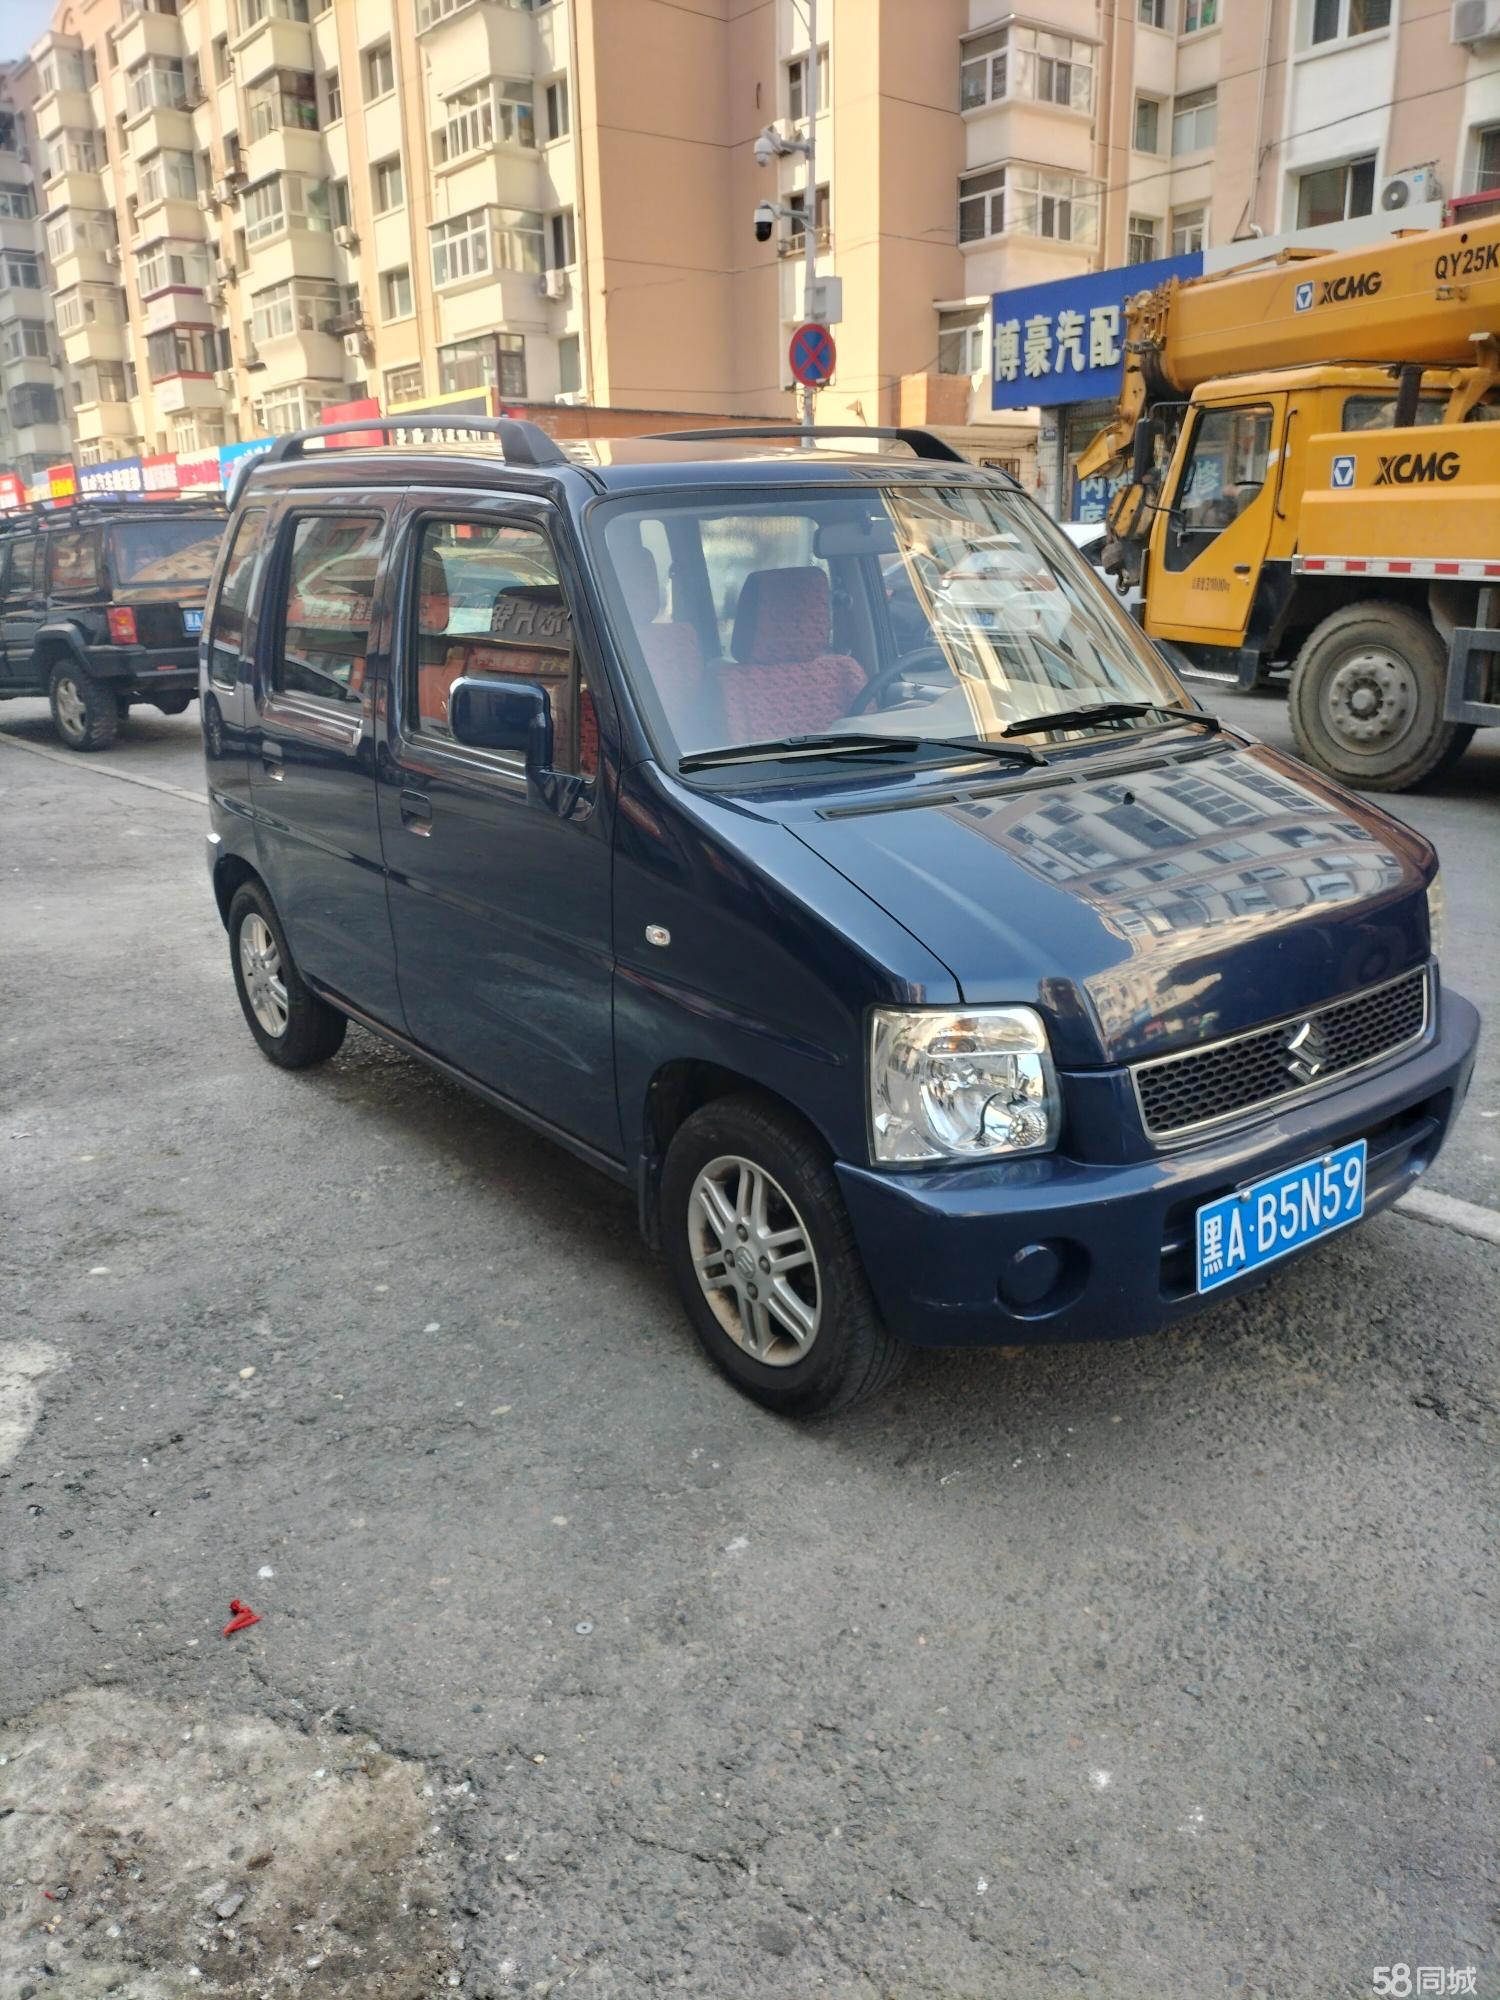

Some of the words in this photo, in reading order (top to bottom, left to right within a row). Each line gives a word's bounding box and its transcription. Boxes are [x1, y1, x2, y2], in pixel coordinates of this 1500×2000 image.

[1317, 271, 1382, 305] XCMG
[994, 305, 1121, 382] 博豪汽配
[1373, 452, 1461, 486] XCMG
